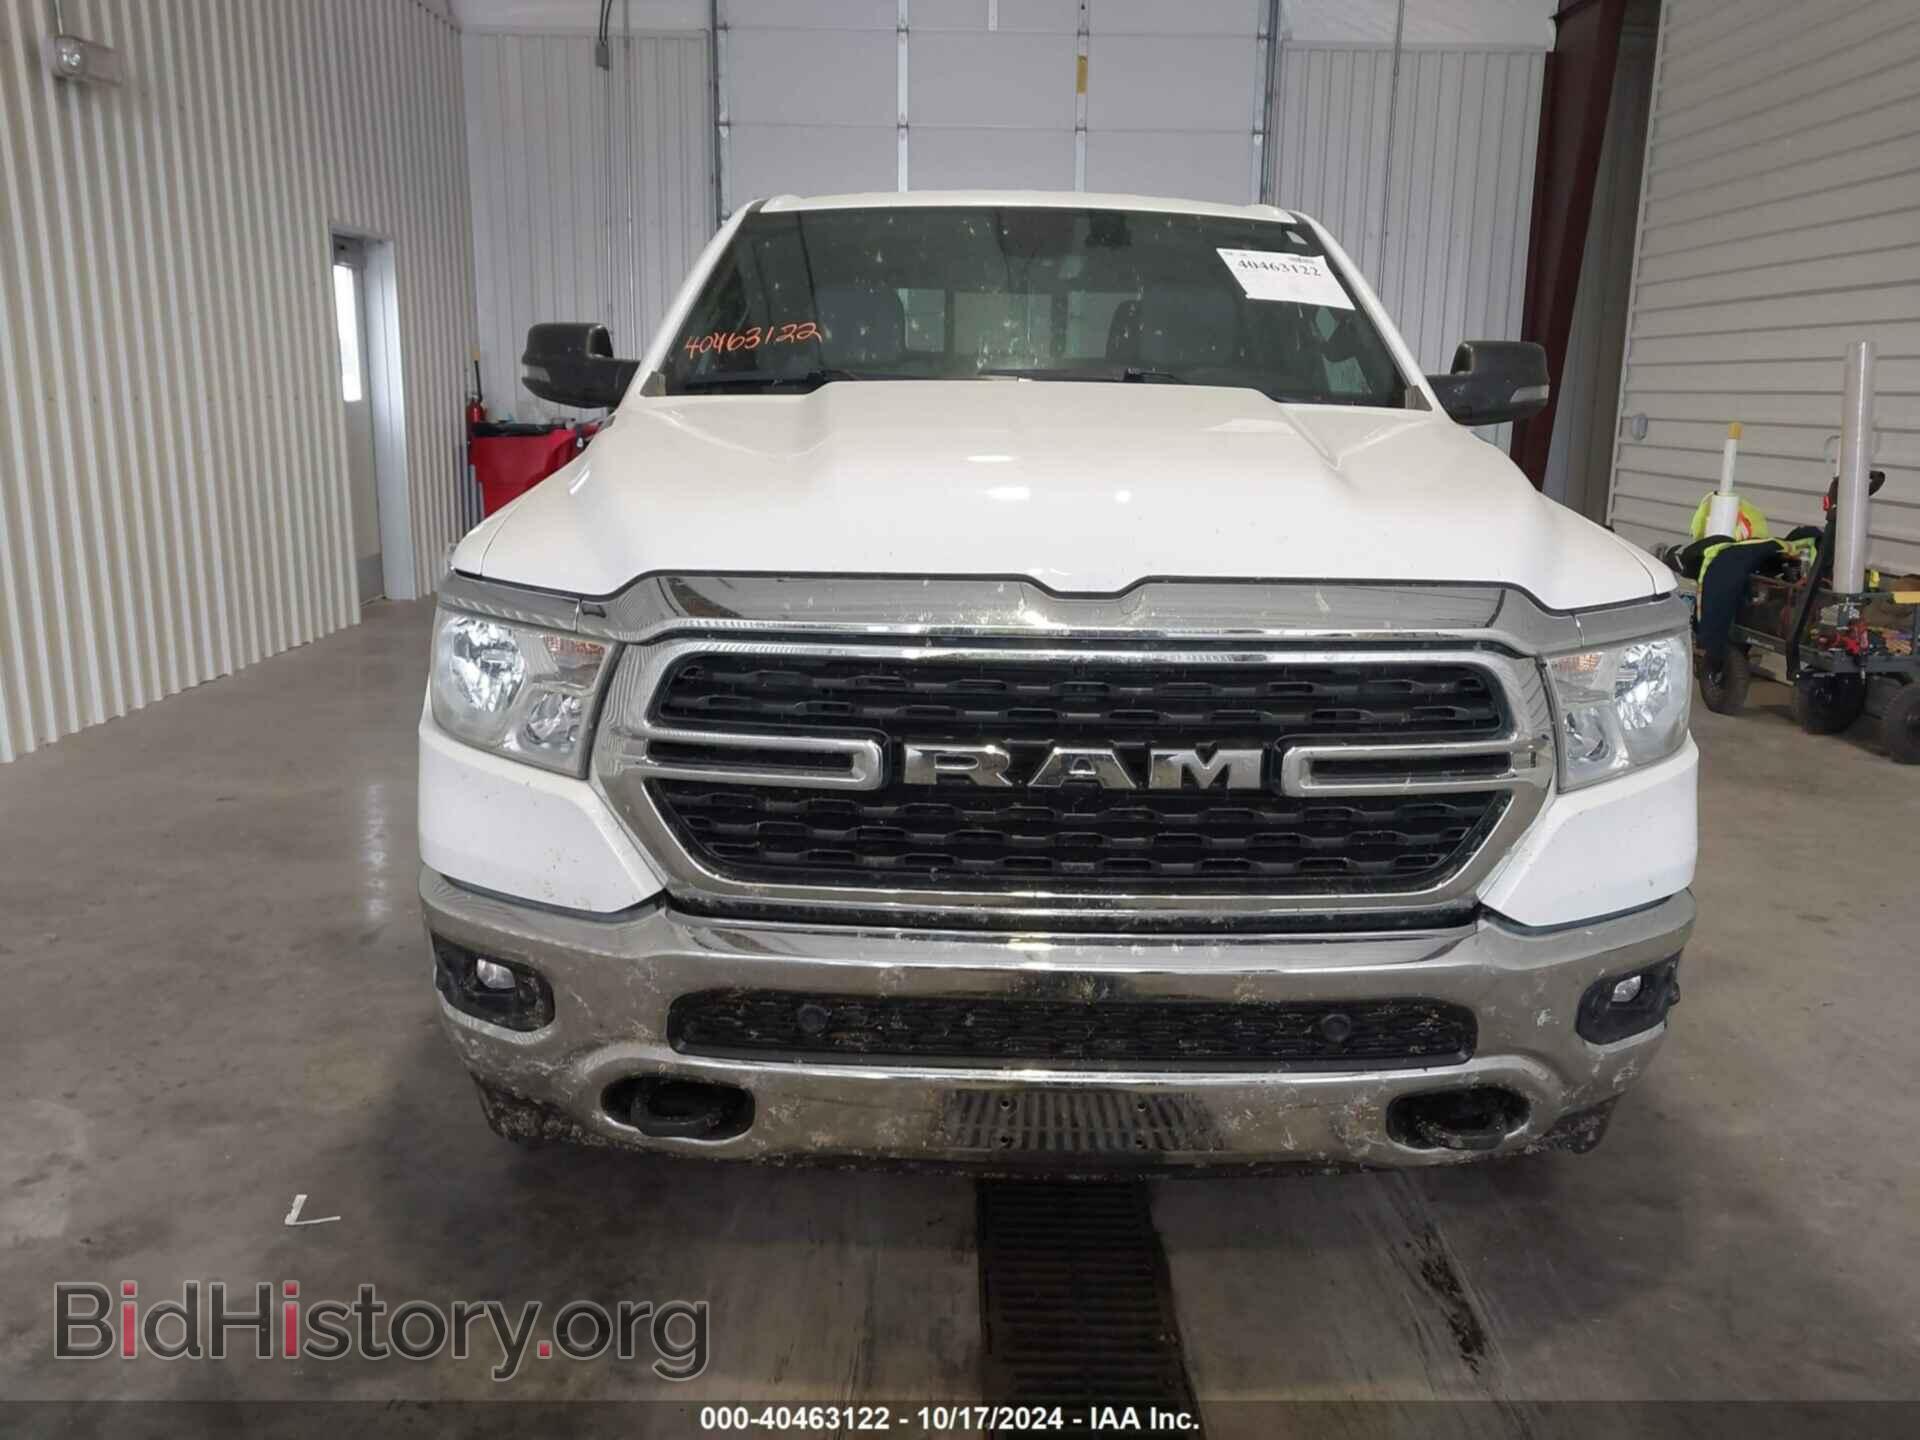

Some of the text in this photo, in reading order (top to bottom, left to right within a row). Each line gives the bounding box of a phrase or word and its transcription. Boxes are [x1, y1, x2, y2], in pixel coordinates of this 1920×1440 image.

[1237, 258, 1321, 277] 40463122
[684, 322, 823, 359] 40463122
[904, 743, 1263, 790] RAM
